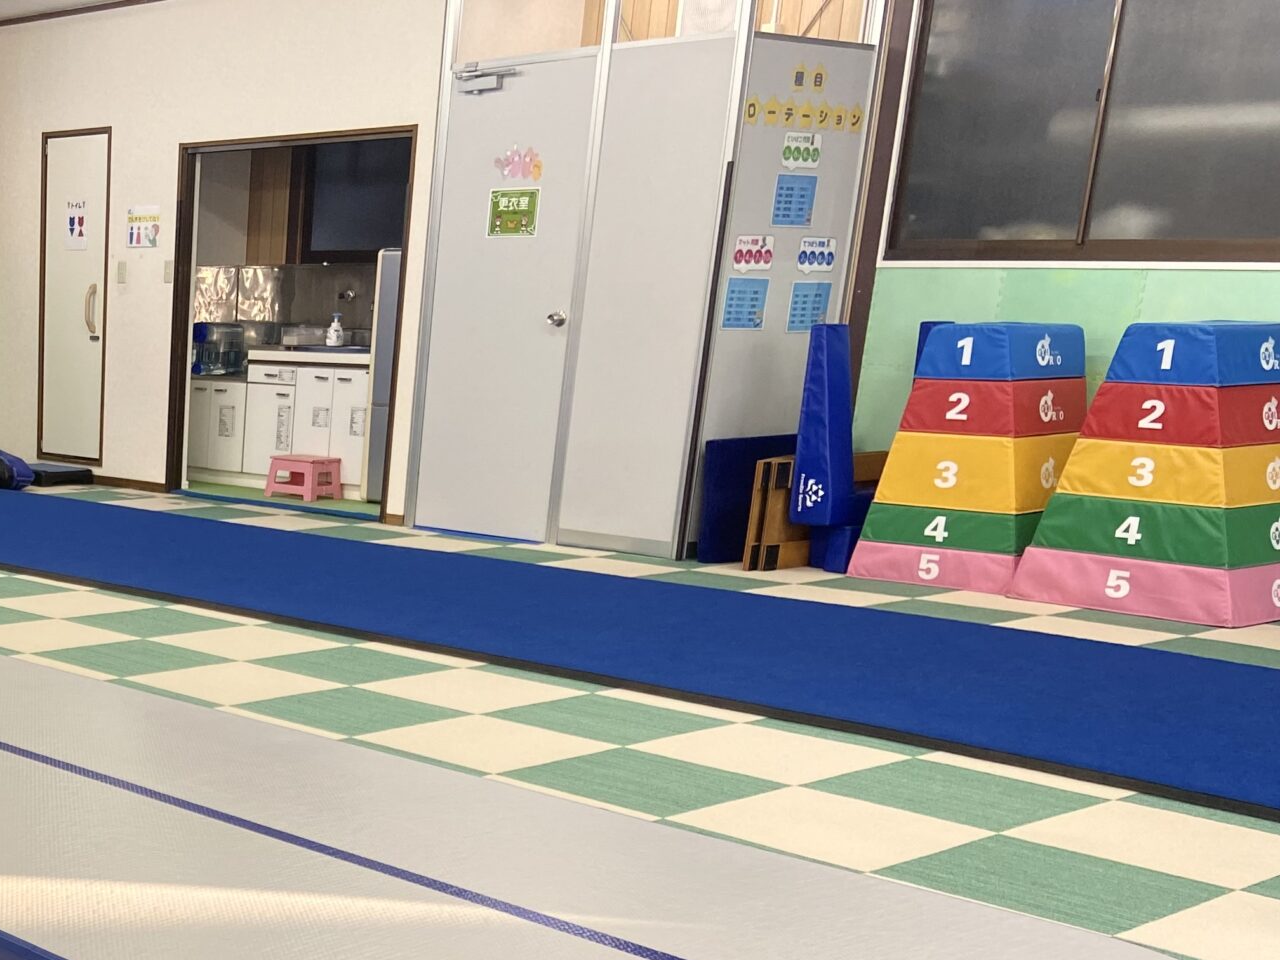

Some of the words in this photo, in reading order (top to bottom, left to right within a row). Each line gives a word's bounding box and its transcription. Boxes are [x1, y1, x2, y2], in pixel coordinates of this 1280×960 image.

[748, 102, 861, 127] ローテーション
[497, 196, 529, 211] 更衣室
[956, 336, 974, 366] 1
[1156, 338, 1176, 370] 1
[945, 391, 971, 421] 2
[1137, 399, 1166, 430] 2
[933, 460, 959, 489] 3
[1127, 456, 1156, 487] 3
[923, 515, 949, 542] 4
[1114, 515, 1142, 545] 4
[917, 553, 940, 581] 5
[1104, 568, 1131, 599] 5
